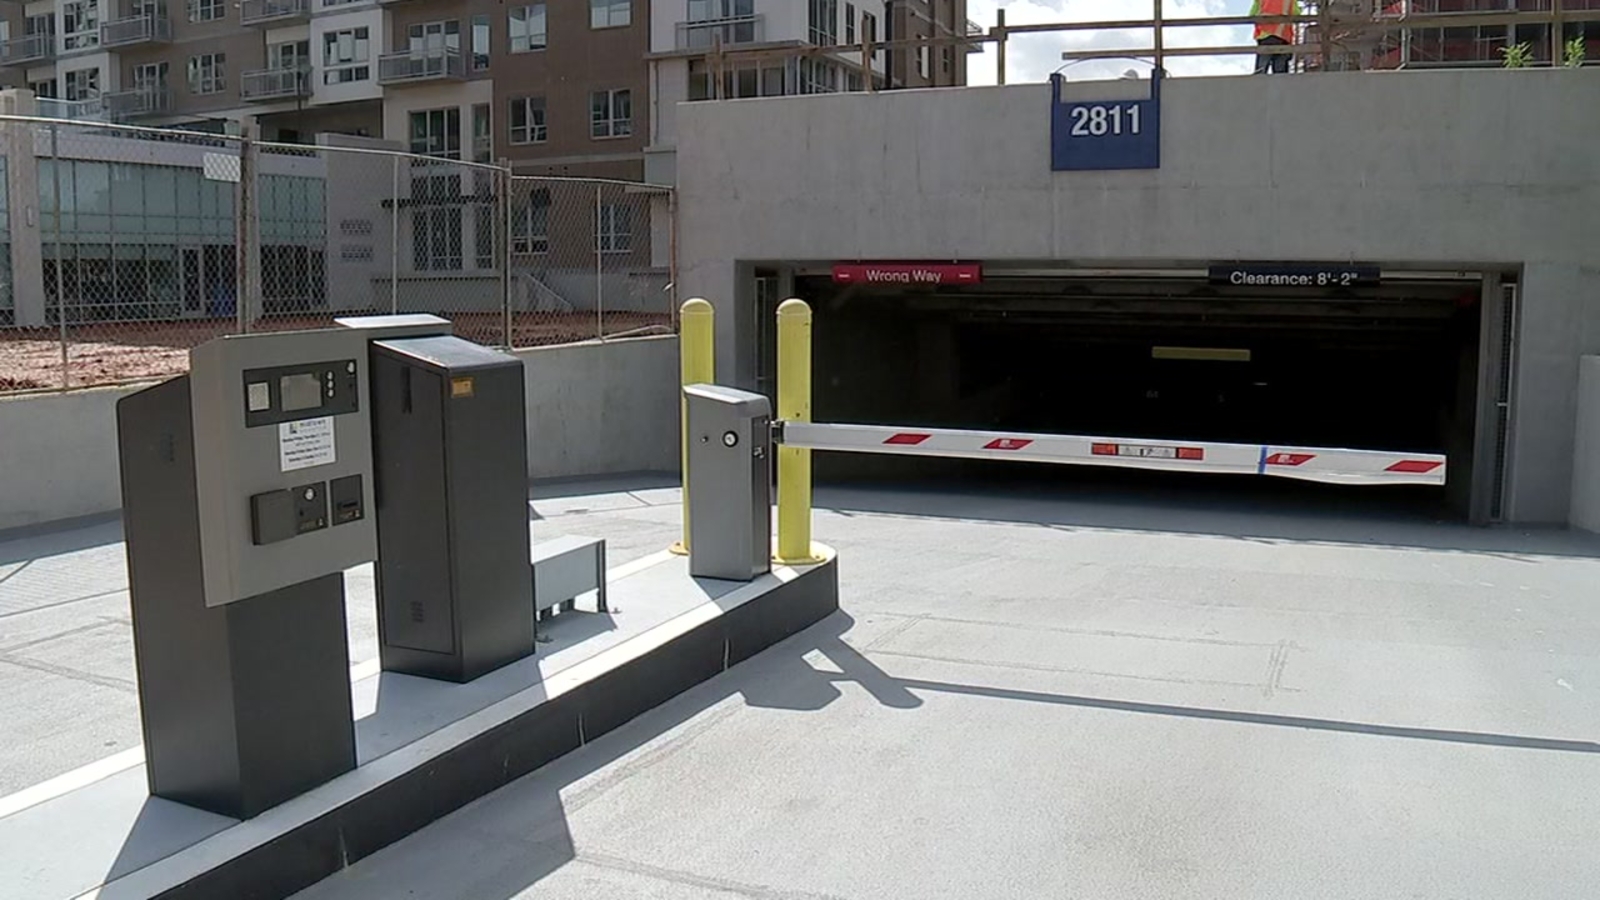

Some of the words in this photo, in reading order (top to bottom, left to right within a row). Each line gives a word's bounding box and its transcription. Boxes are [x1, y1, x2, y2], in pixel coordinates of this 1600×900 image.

[1071, 104, 1140, 136] 2811
[866, 269, 909, 283] Wrong
[912, 269, 942, 284] Way
[1230, 270, 1312, 286] Clearance:
